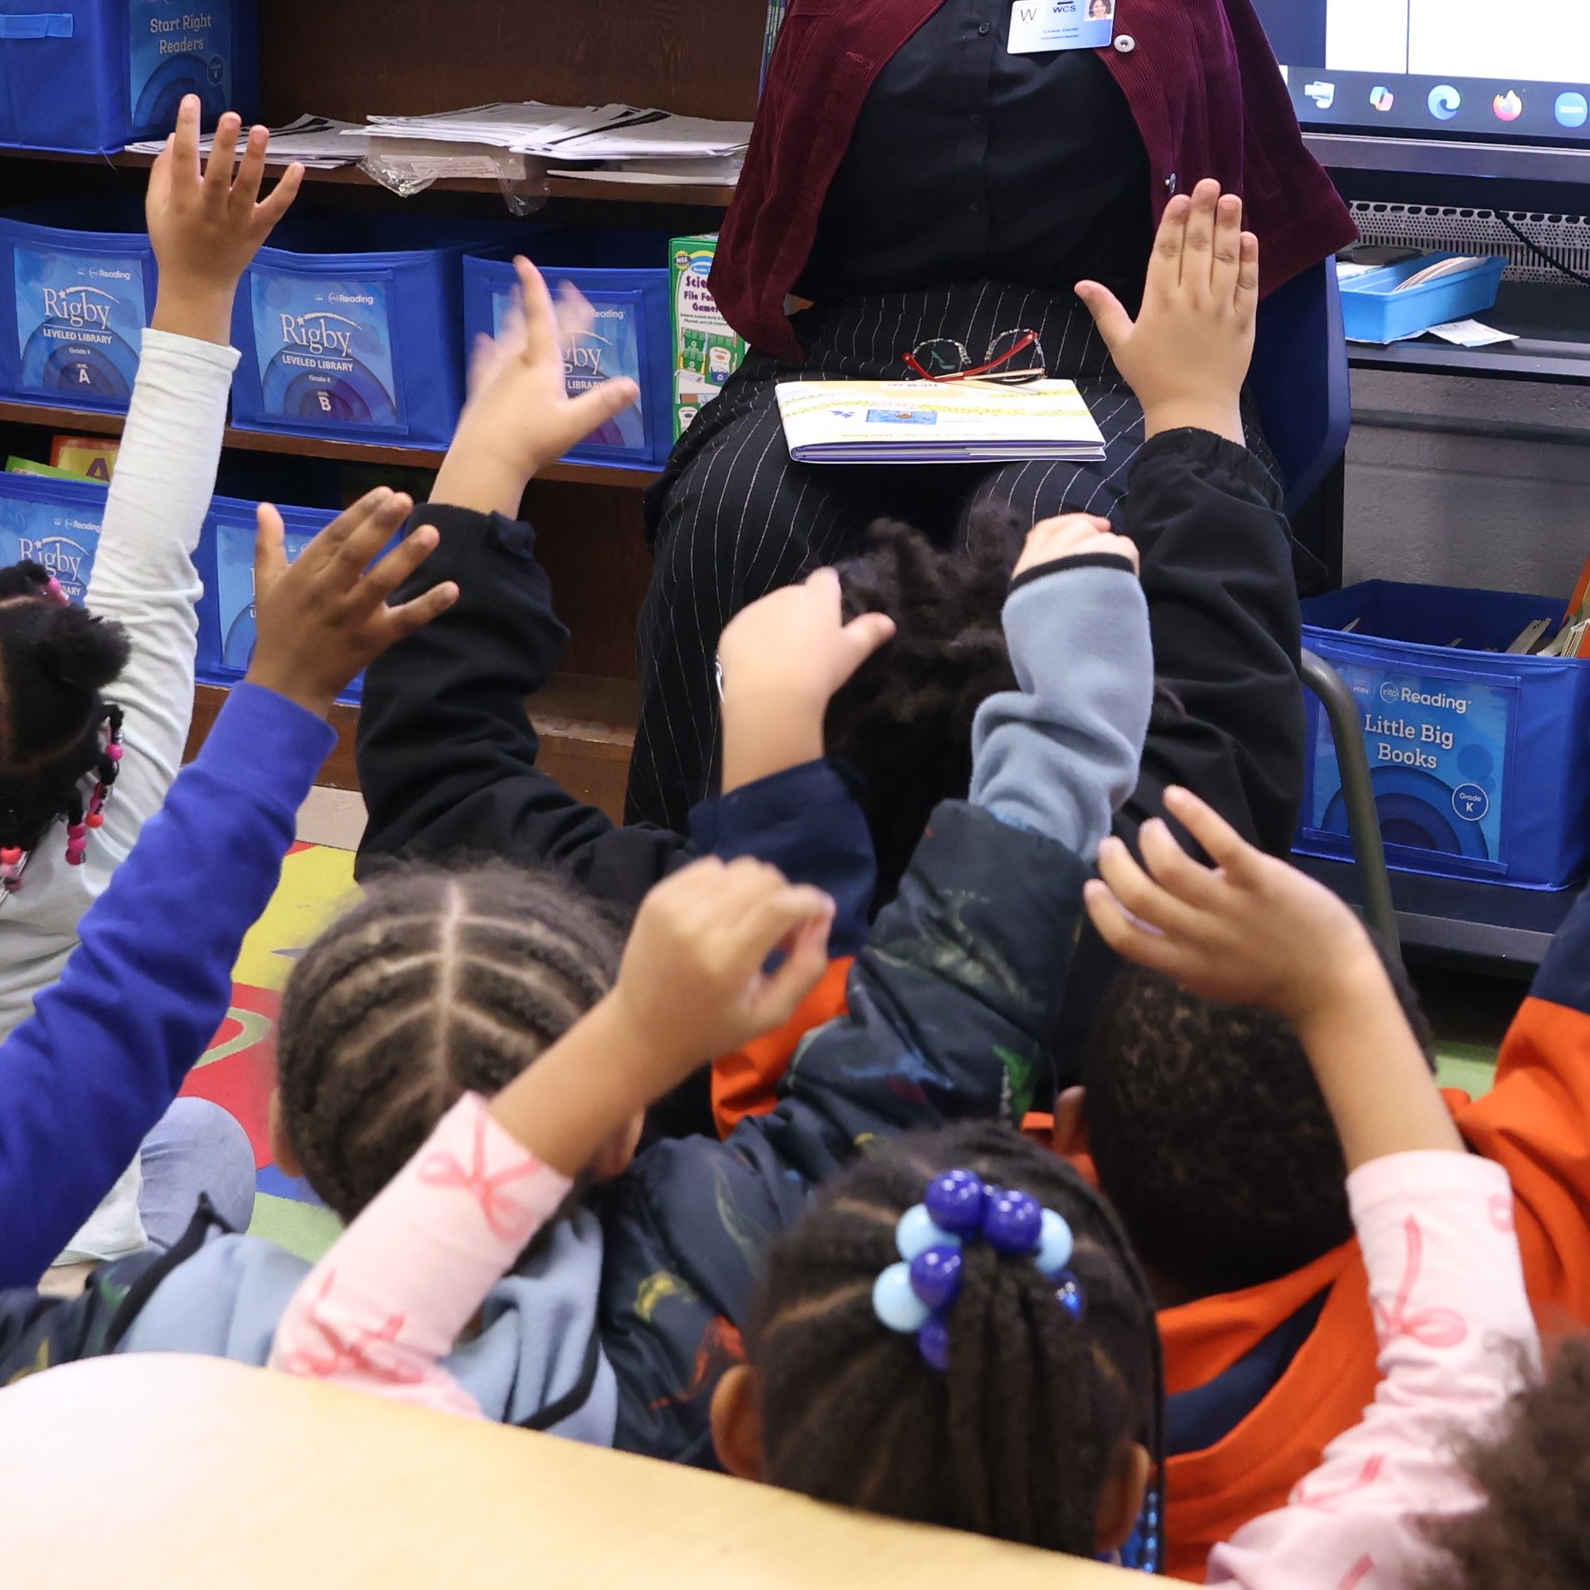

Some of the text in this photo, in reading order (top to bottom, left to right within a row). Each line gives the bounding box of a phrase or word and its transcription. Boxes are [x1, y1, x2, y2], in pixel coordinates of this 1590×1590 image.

[1053, 5, 1076, 13] WCS
[150, 13, 212, 33] Start Right
[159, 36, 204, 54] Readers
[98, 269, 131, 281] Reading
[686, 275, 707, 288] Scie
[339, 294, 374, 305] Reading
[684, 291, 698, 300] File
[42, 287, 110, 330] Rigby
[43, 328, 112, 345] LEVELED LIBRARY
[280, 313, 351, 357] Rigby
[282, 355, 353, 372] LEVELED LIBRARY
[562, 335, 601, 375] gby
[78, 368, 90, 384] A
[318, 396, 332, 411] B
[73, 520, 101, 532] Reading
[19, 537, 82, 582] Rigby
[1401, 687, 1467, 714] Reading
[1364, 714, 1454, 750] Little Big
[1377, 742, 1438, 769] Books
[1459, 792, 1482, 803] Grade
[1466, 802, 1474, 813] K
